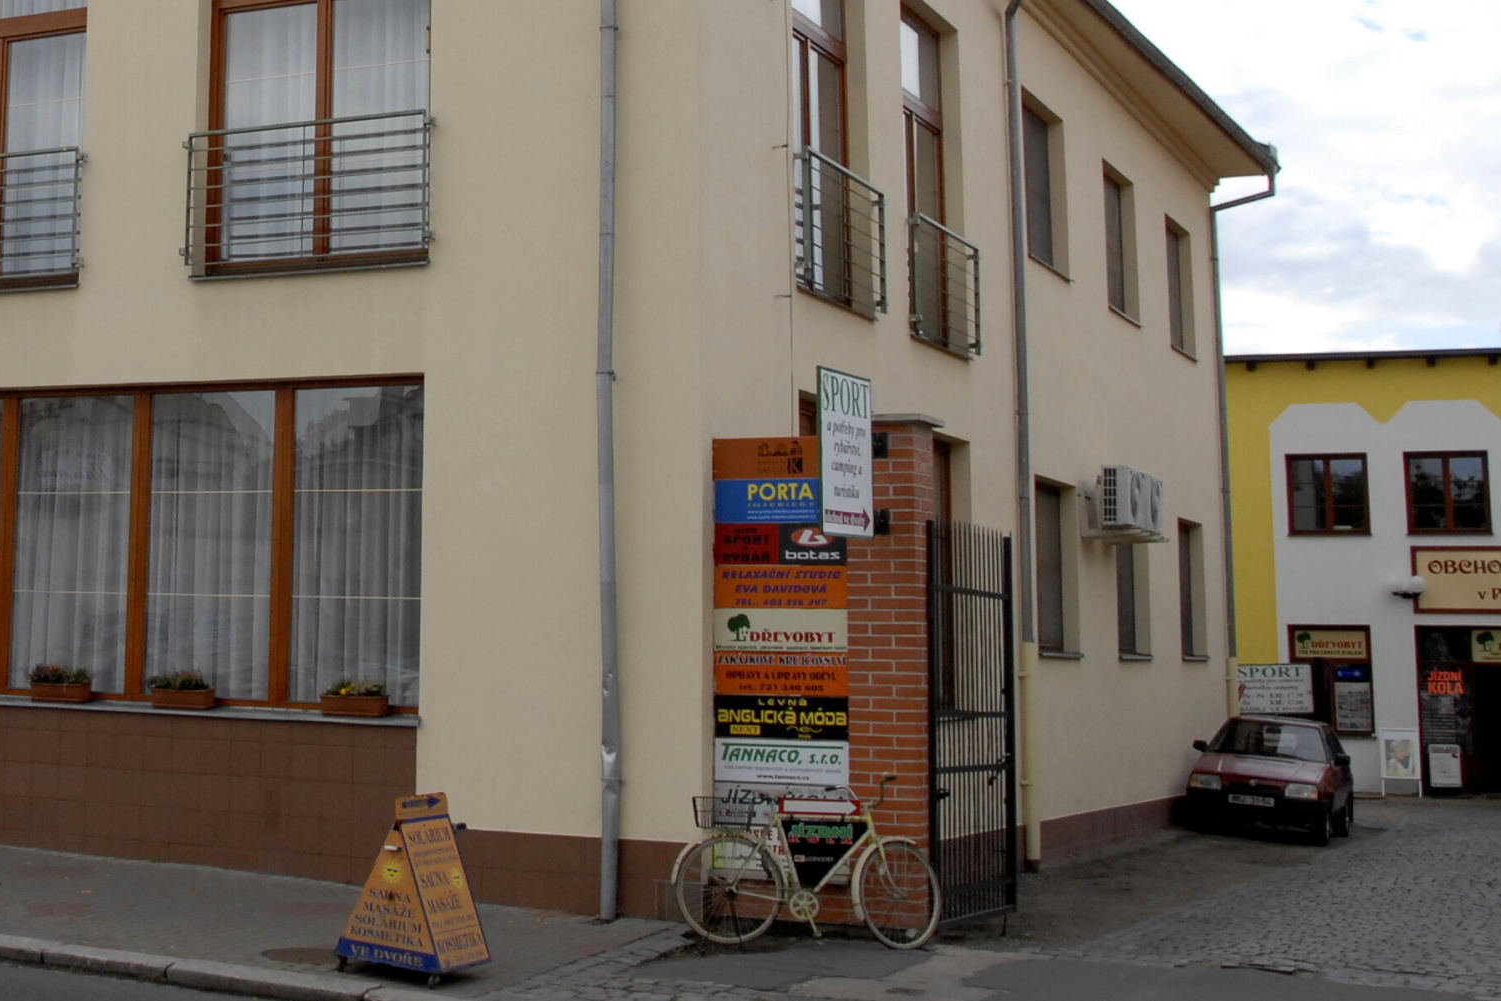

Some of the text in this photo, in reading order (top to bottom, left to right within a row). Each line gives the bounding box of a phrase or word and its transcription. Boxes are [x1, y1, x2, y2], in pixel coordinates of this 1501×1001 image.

[823, 373, 869, 419] SPORT
[856, 427, 866, 439] pro
[831, 459, 857, 478] camping
[748, 483, 813, 501] PORTA
[785, 550, 841, 560] botas
[722, 568, 841, 579] RELAXAČNÍ STUDIO
[1428, 559, 1501, 574] OBCHO
[735, 584, 827, 594] EVA DAVIDOVÁ
[1478, 590, 1486, 599] v
[750, 629, 835, 643] DŘEVOBYT
[1311, 639, 1363, 649] DŘEVOBYT
[717, 652, 847, 667] ZAKÁZKOVÉ KREJČOVSTVÍ
[726, 670, 761, 680] OPRAVY
[763, 671, 770, 680] A
[1237, 666, 1303, 678] SPORT
[1428, 682, 1466, 695] KOLA
[758, 697, 808, 706] LEVNÁ
[731, 726, 759, 735] NEXT
[721, 742, 842, 766] TANNACO, s.r.o.
[407, 823, 451, 846] SOLÁRIUM
[788, 822, 853, 839] JÍZDNÍ
[788, 835, 853, 845] KOLA
[420, 871, 449, 890] SAUNA
[363, 901, 416, 919] MASÁŽE
[427, 890, 462, 915] MASÁŽE
[355, 914, 422, 934] SOLÁRIUM
[350, 925, 423, 947] KOSMETIKA
[437, 932, 484, 954] KOSMETIKA
[351, 944, 423, 967] VE DVOŘE
